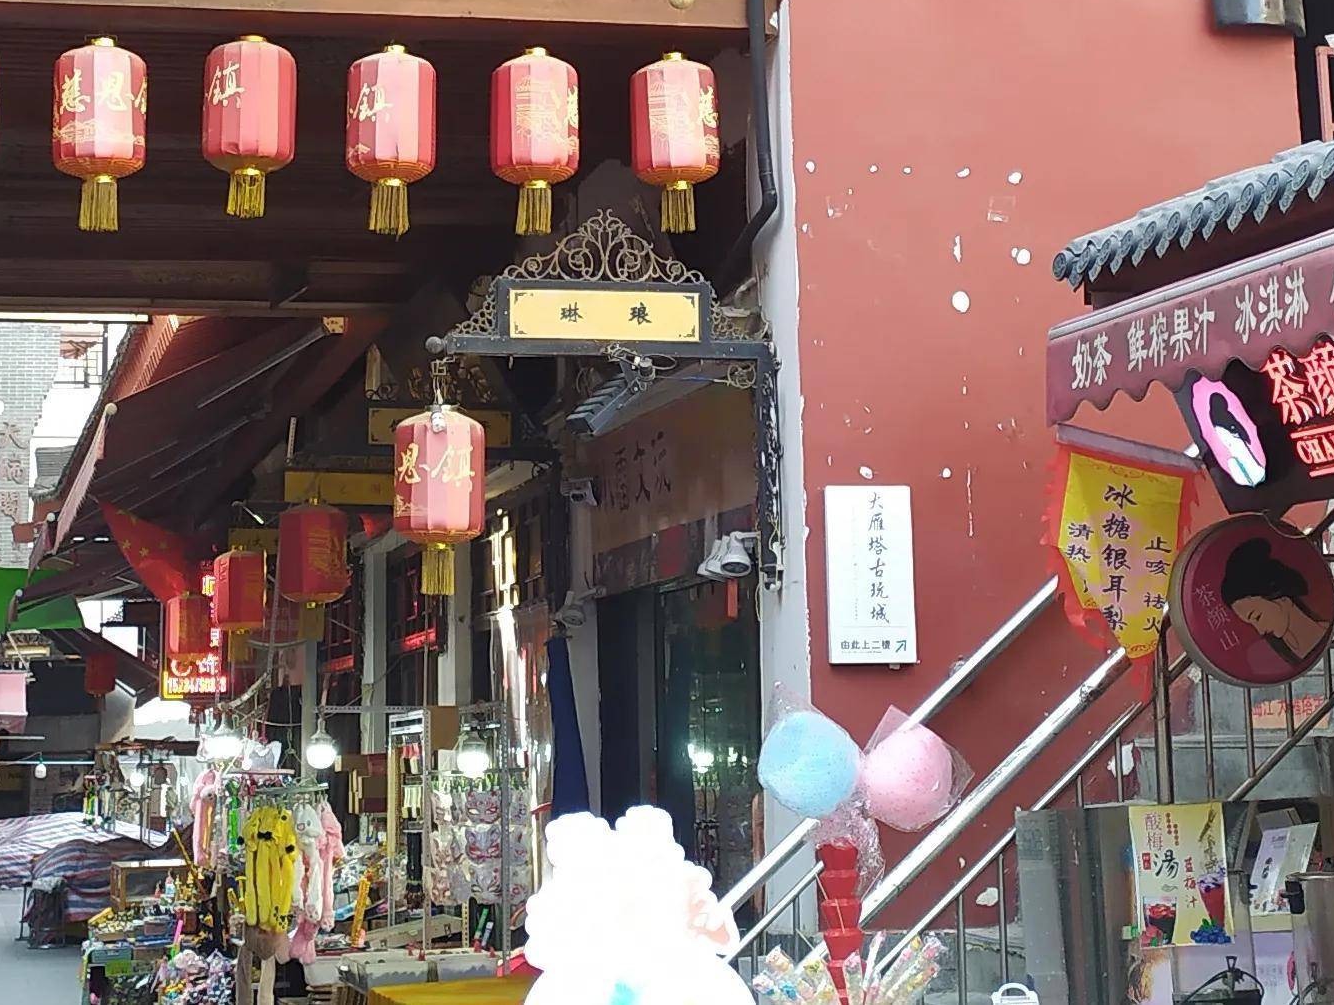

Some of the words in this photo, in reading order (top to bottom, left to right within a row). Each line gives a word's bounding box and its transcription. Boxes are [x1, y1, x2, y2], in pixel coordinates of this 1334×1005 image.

[1071, 331, 1113, 390] 奶茶
[1126, 299, 1215, 373] 鲜榨果汁
[1234, 269, 1309, 339] 冰淇淋
[868, 492, 890, 624] 大雁塔古玩城
[1102, 483, 1138, 632] 冰糖银耳梨
[1195, 585, 1241, 653] 茶颜山
